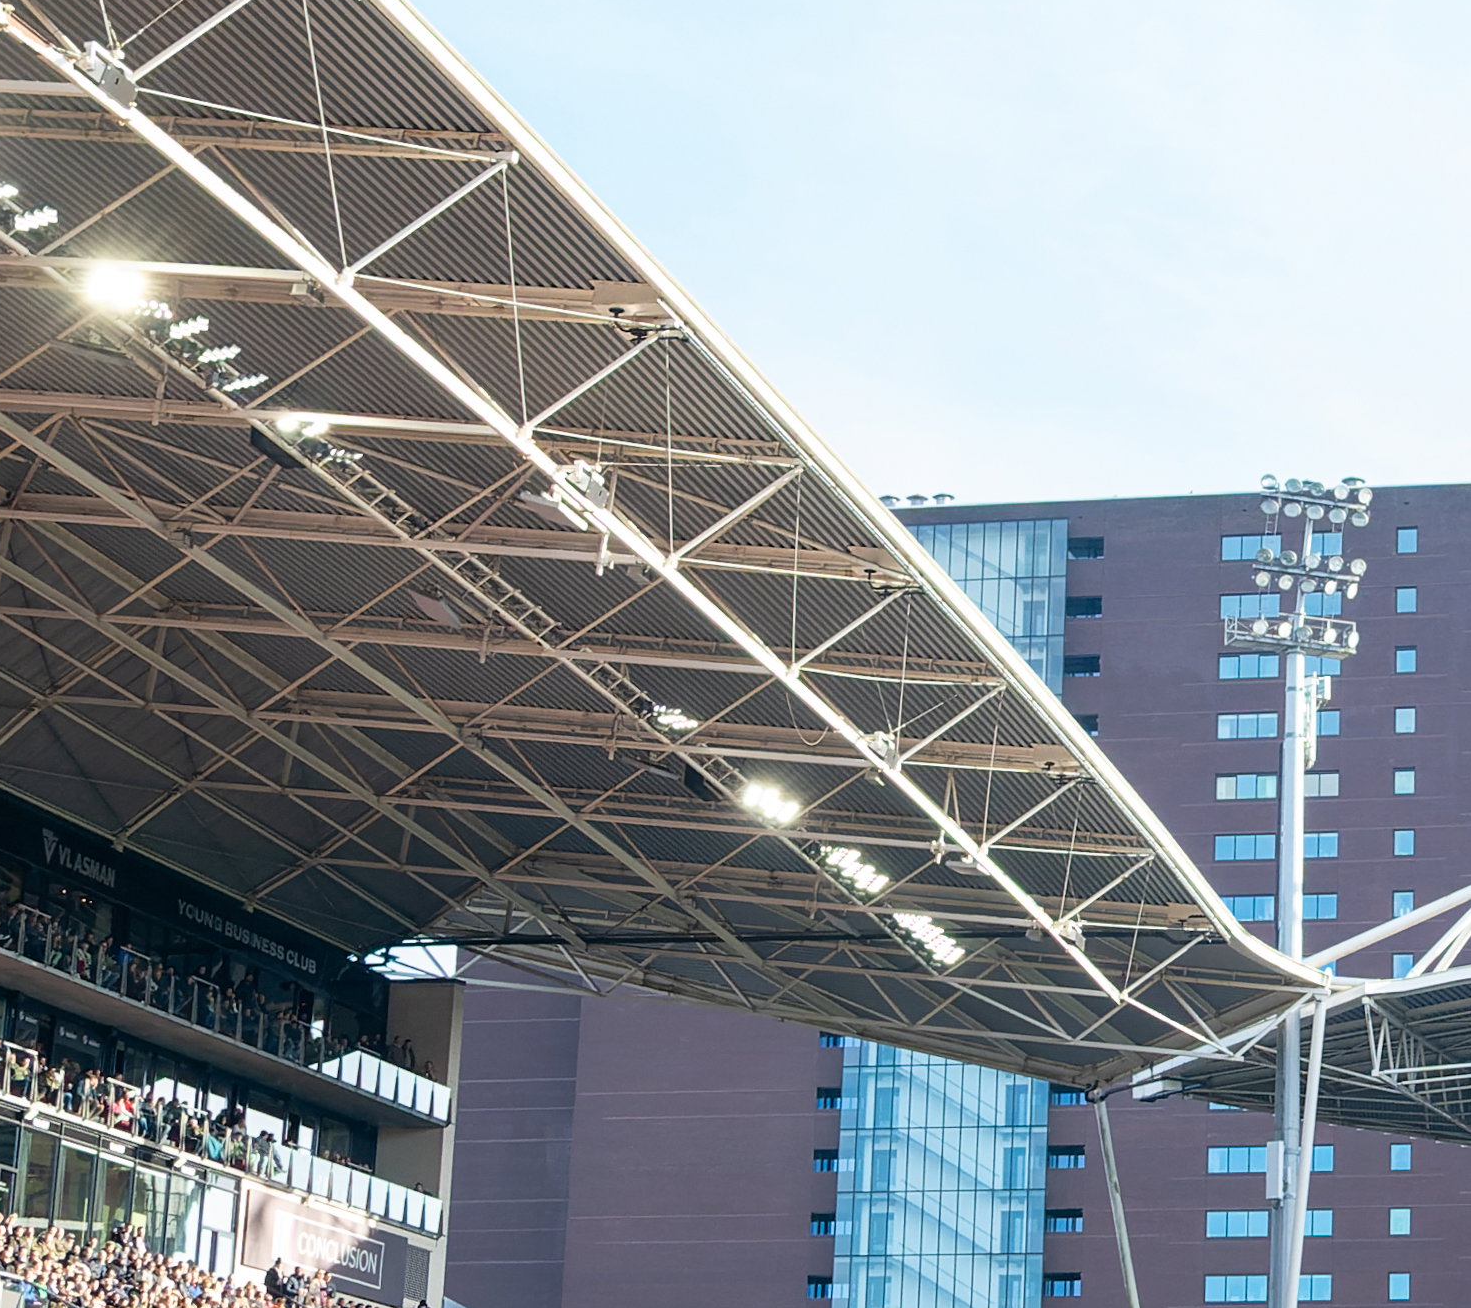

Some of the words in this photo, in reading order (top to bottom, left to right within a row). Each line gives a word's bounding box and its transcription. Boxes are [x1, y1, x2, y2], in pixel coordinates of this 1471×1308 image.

[59, 844, 117, 888] VLASMAN
[178, 899, 223, 932] YOUNG
[225, 920, 285, 961] BUSINESS
[286, 949, 317, 975] CLUB
[298, 1231, 378, 1275] CONCLUSION
